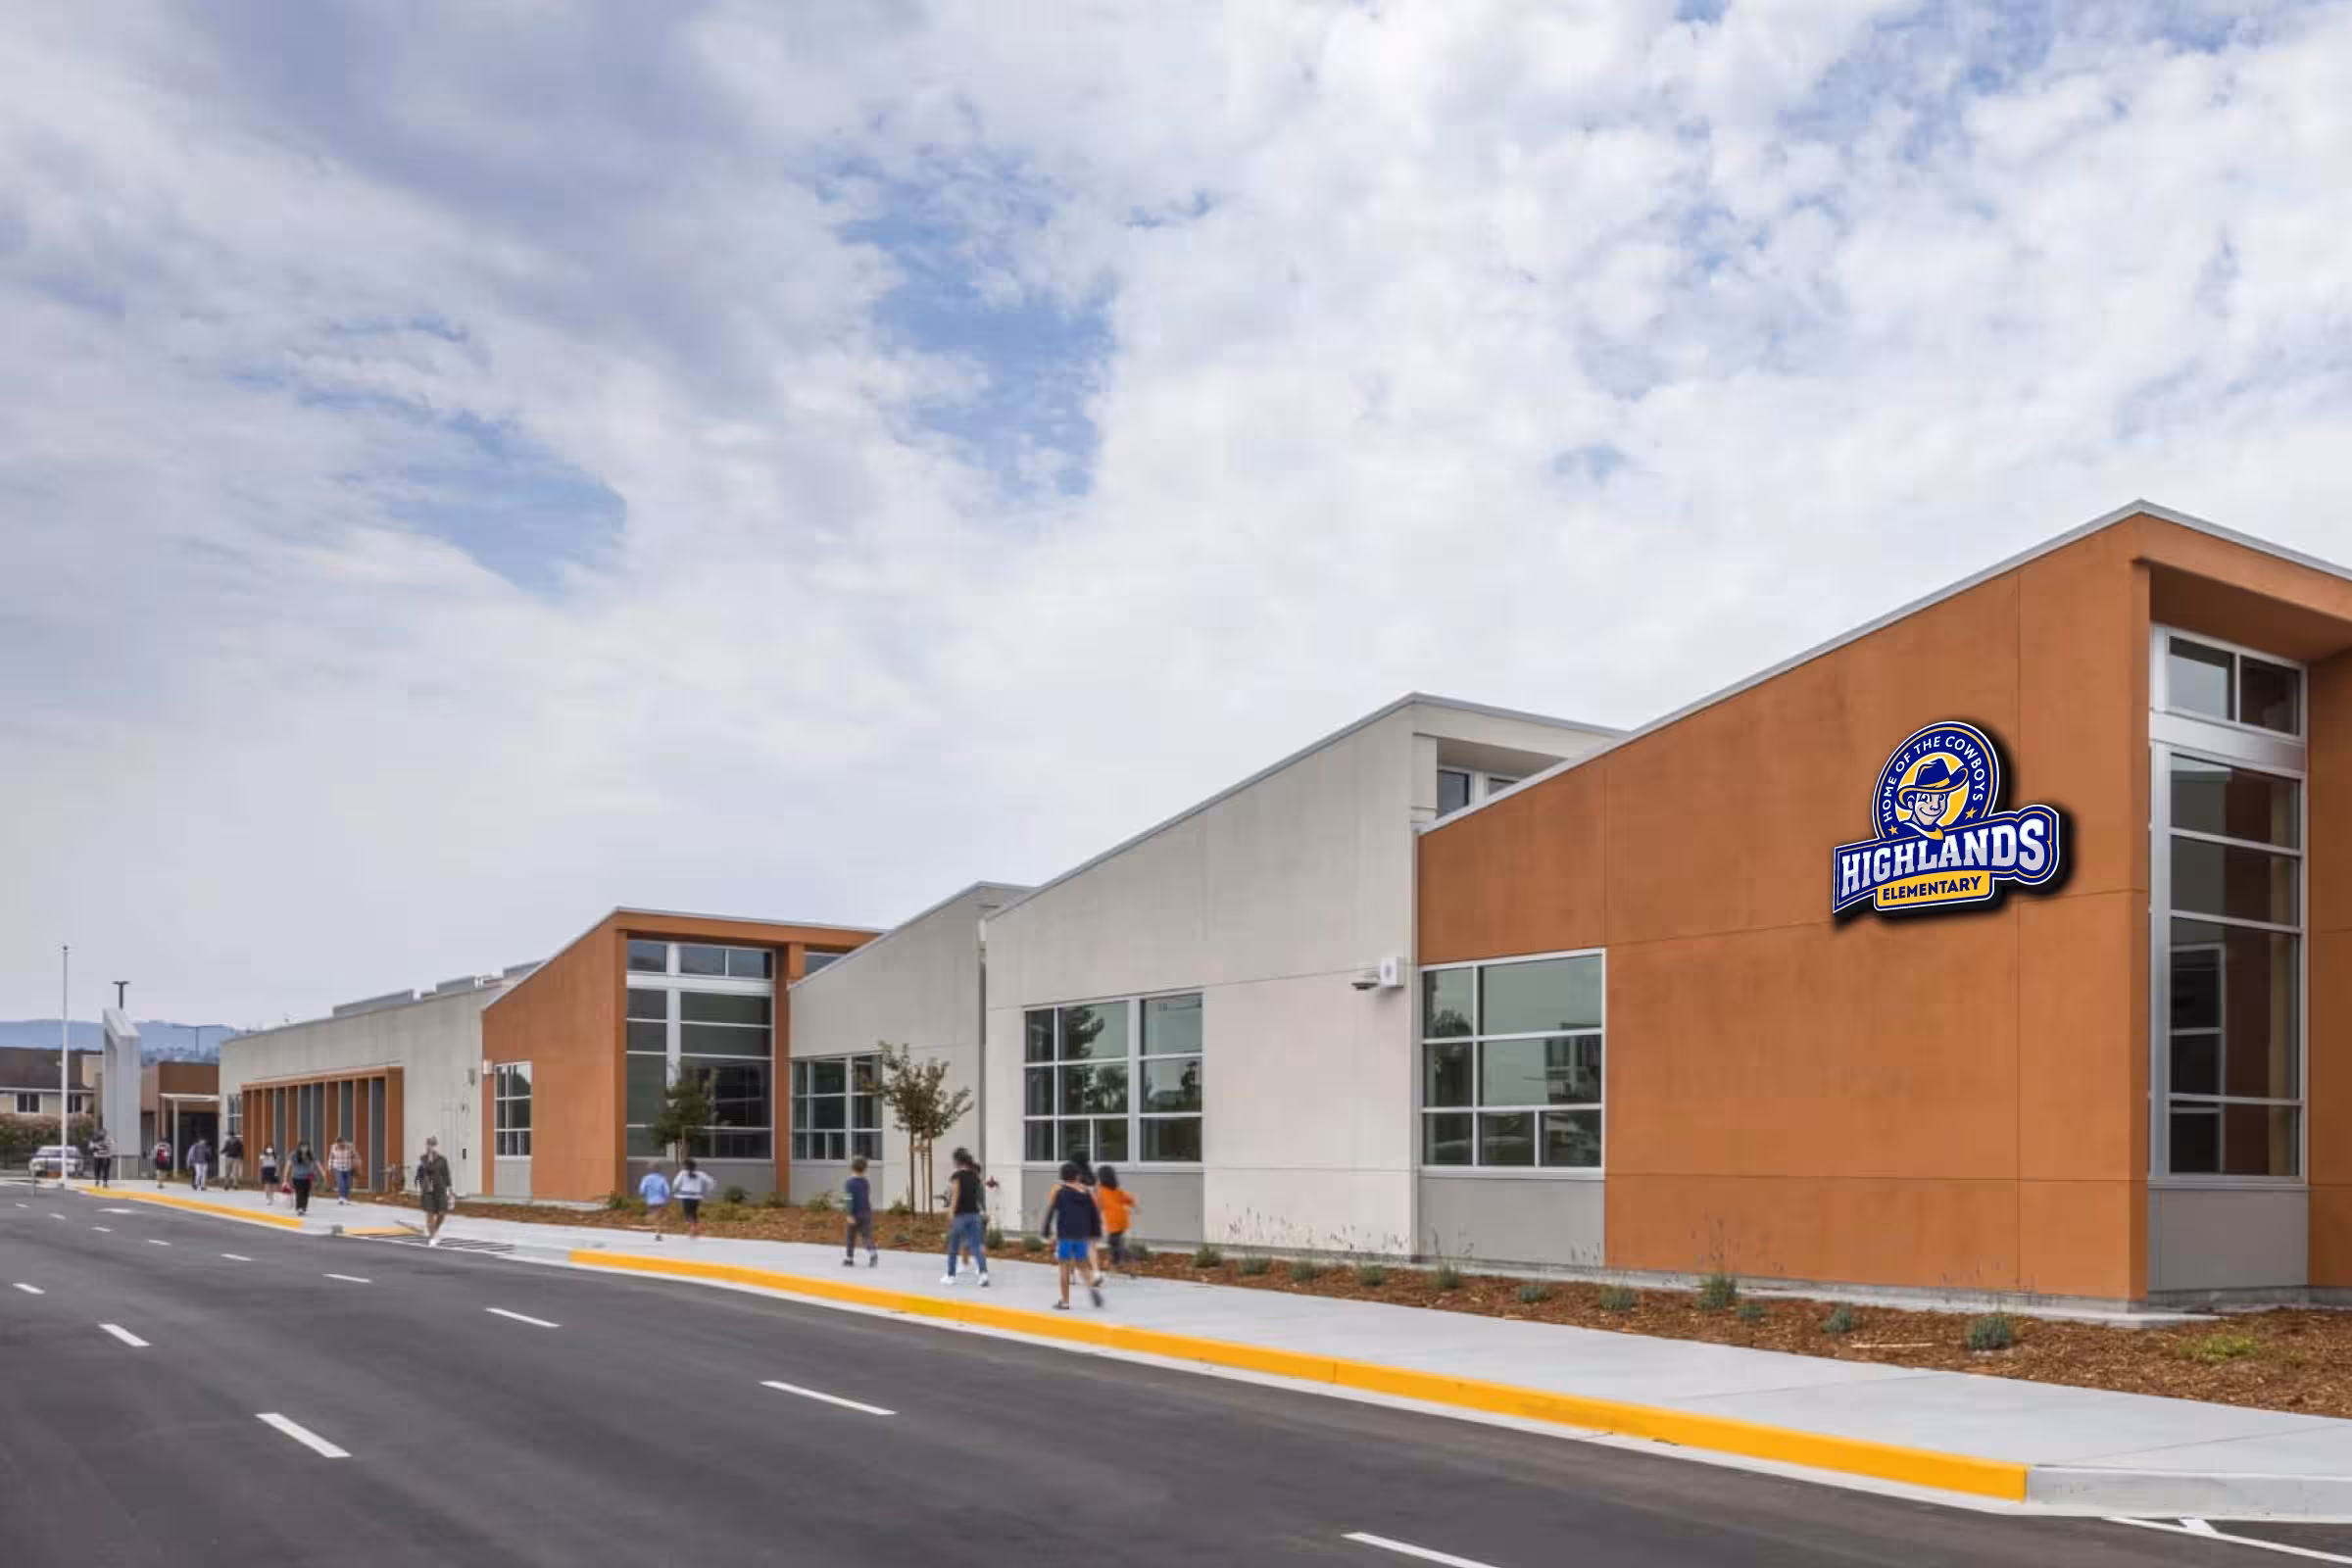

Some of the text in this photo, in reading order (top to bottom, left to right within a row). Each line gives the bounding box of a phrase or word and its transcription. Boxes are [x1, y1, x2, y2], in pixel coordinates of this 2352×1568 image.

[1883, 735, 1985, 822] HOME OF THE COWBOYS
[1840, 818, 2045, 898] HIGHLANDS
[1883, 875, 1982, 901] ELEMENTARY
